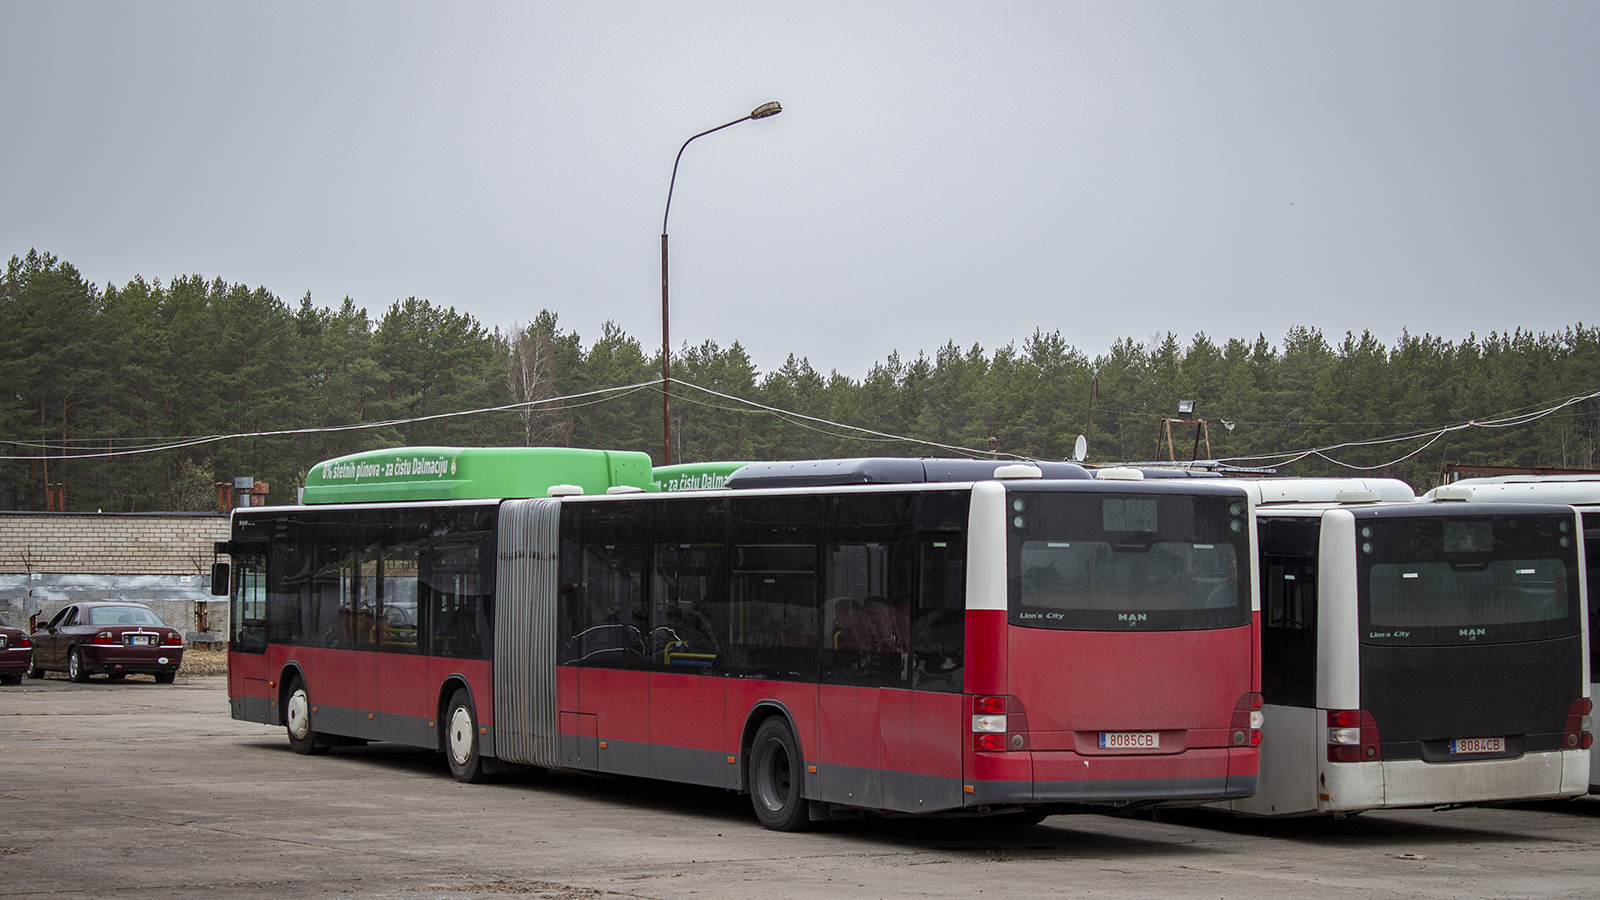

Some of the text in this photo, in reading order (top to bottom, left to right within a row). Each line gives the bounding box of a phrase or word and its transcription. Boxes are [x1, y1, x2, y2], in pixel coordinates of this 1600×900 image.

[322, 463, 333, 480] 0%
[355, 461, 380, 482] plinova
[385, 463, 394, 477] za
[394, 457, 411, 476] čistu
[412, 456, 448, 478] Dalmaciju
[668, 479, 678, 492] za
[680, 473, 700, 490] čistu
[1046, 612, 1065, 620] City
[1118, 613, 1147, 621] MAN
[1393, 630, 1411, 638] City
[1459, 628, 1486, 636] MAN
[1110, 734, 1154, 746] 8085CB
[1460, 739, 1500, 752] 8084CB
